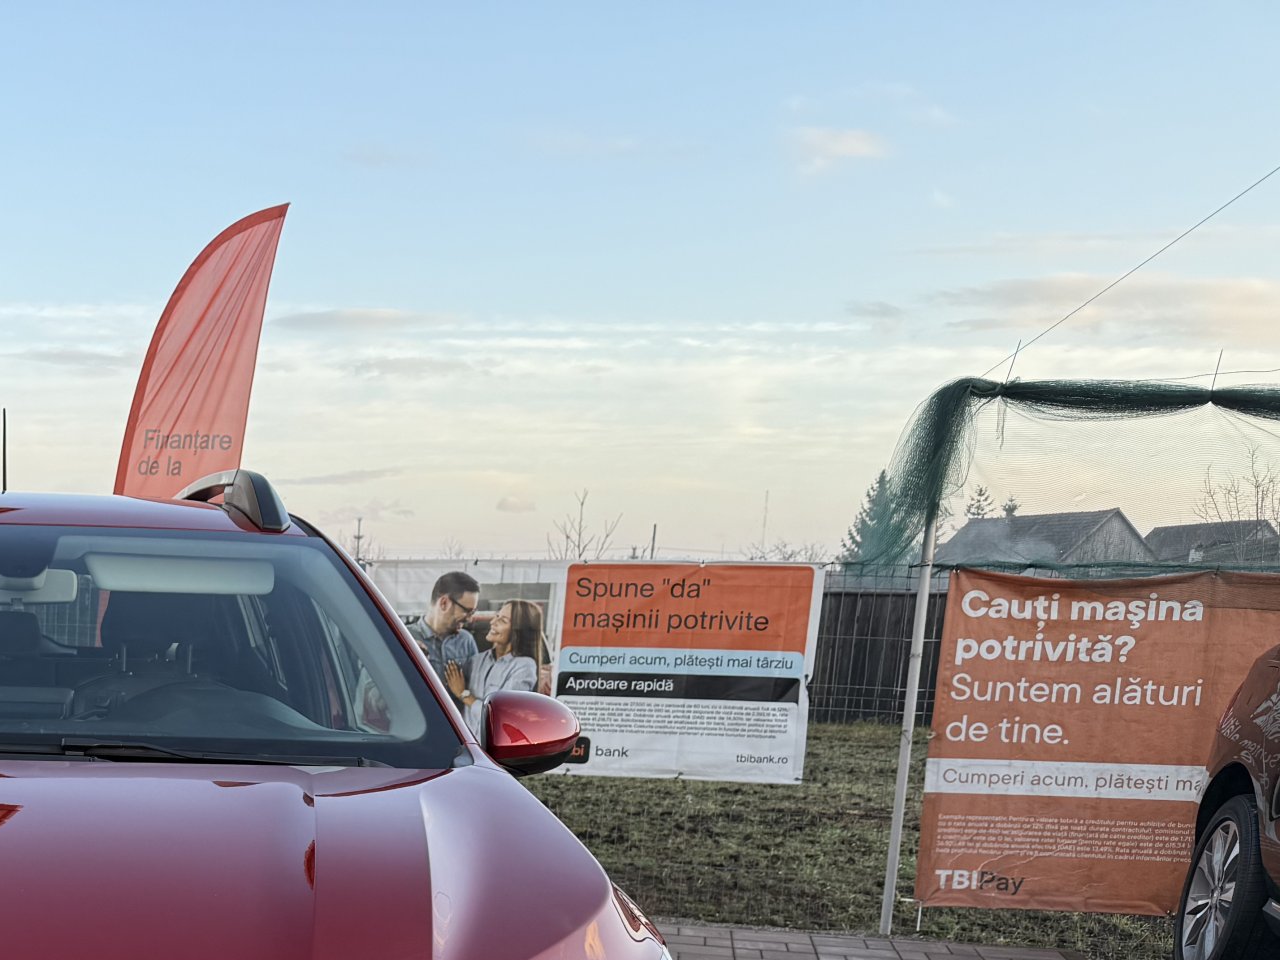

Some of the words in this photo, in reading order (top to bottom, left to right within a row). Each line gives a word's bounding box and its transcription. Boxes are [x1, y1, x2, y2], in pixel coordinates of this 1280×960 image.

[137, 455, 160, 476] de
[166, 455, 182, 476] la
[575, 577, 654, 601] Spune
[662, 578, 711, 599] "da"
[573, 609, 660, 633] mașinii
[666, 610, 769, 633] potrivite
[954, 632, 1136, 665] potrivită?
[568, 652, 626, 667] Cumperi
[628, 655, 670, 668] acum,
[726, 656, 752, 669] mai
[755, 656, 794, 670] târziu
[565, 676, 628, 692] Aprobare
[630, 678, 674, 693] rapidă
[950, 672, 1081, 704] Suntem
[1092, 677, 1204, 706] alături
[945, 714, 989, 743] de
[997, 716, 1070, 745] tine.
[594, 745, 630, 758] bank
[735, 754, 789, 765] tbibank.ro
[941, 768, 1025, 790] Cumperi
